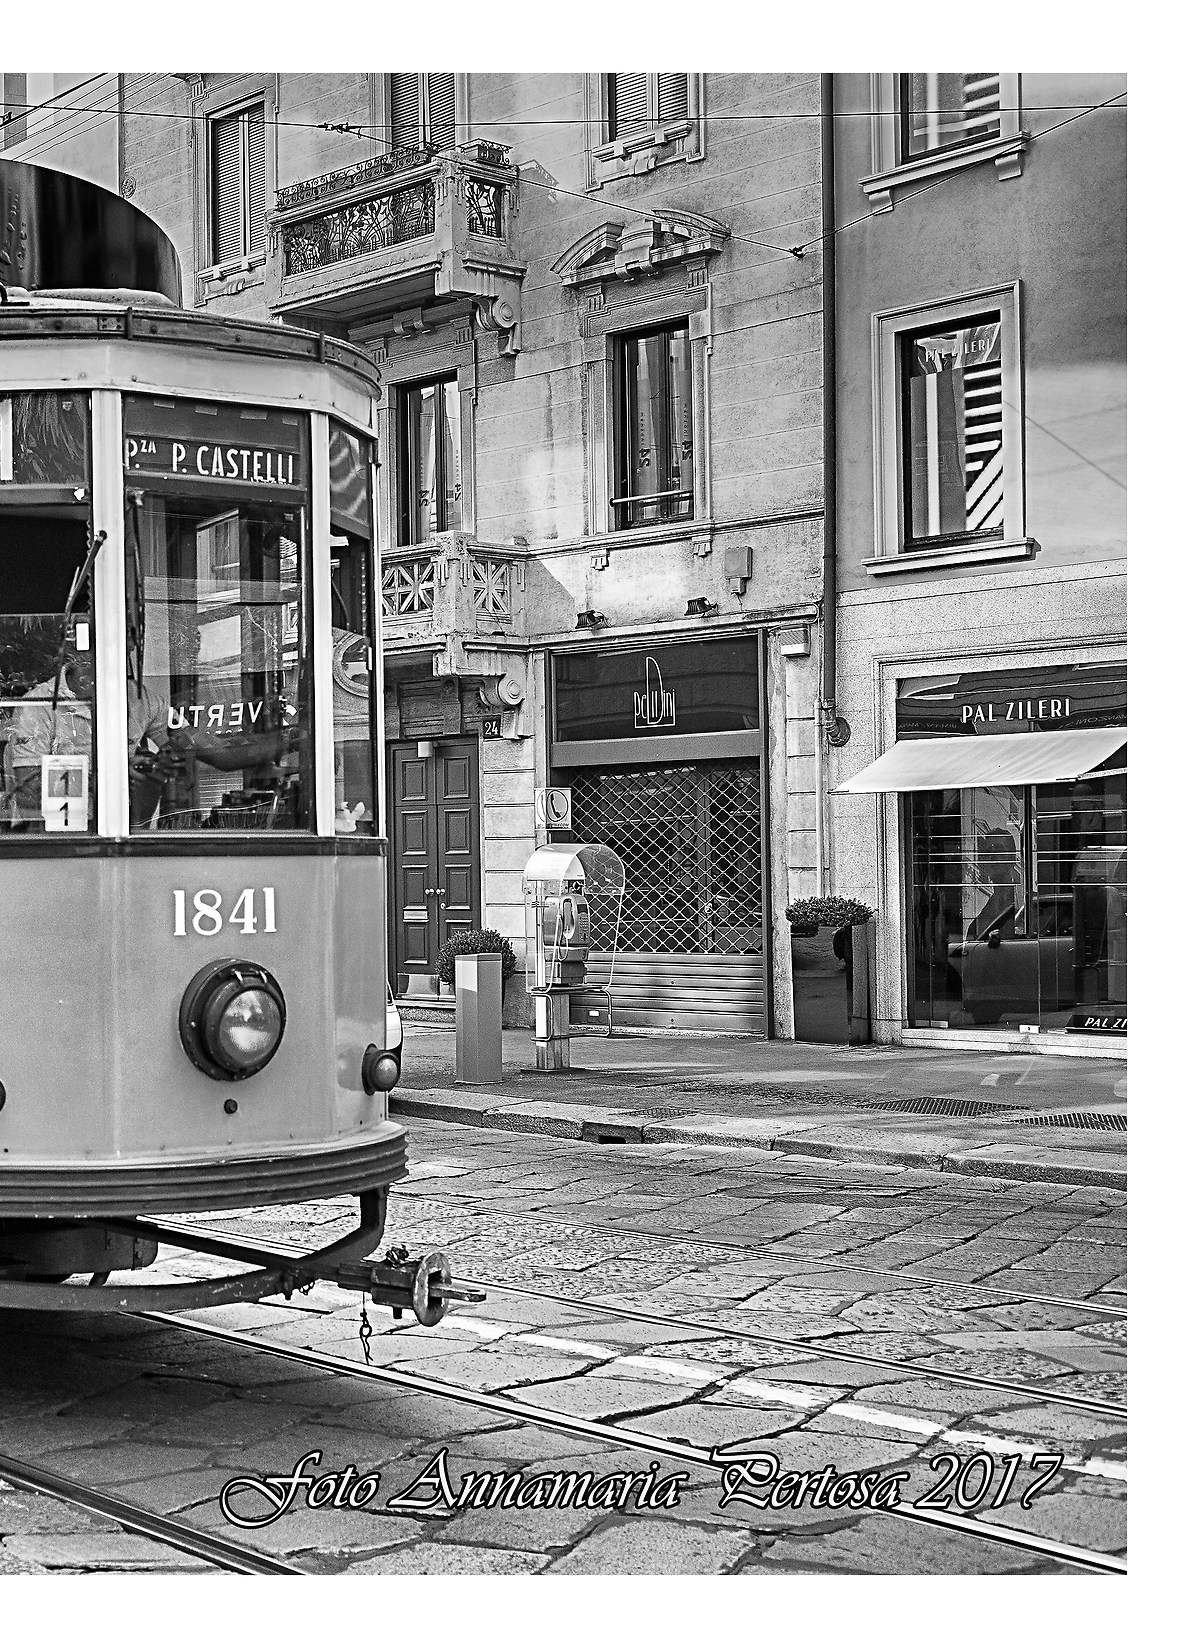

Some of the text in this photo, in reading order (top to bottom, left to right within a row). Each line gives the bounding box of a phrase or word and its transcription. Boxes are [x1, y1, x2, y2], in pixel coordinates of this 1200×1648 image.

[196, 445, 293, 484] CASTELLI
[962, 698, 1070, 724] PAL ZILERI
[484, 720, 499, 736] 24
[60, 770, 69, 796] 1
[60, 802, 69, 826] 1
[173, 886, 277, 936] 1841
[1084, 1017, 1109, 1028] PAL
